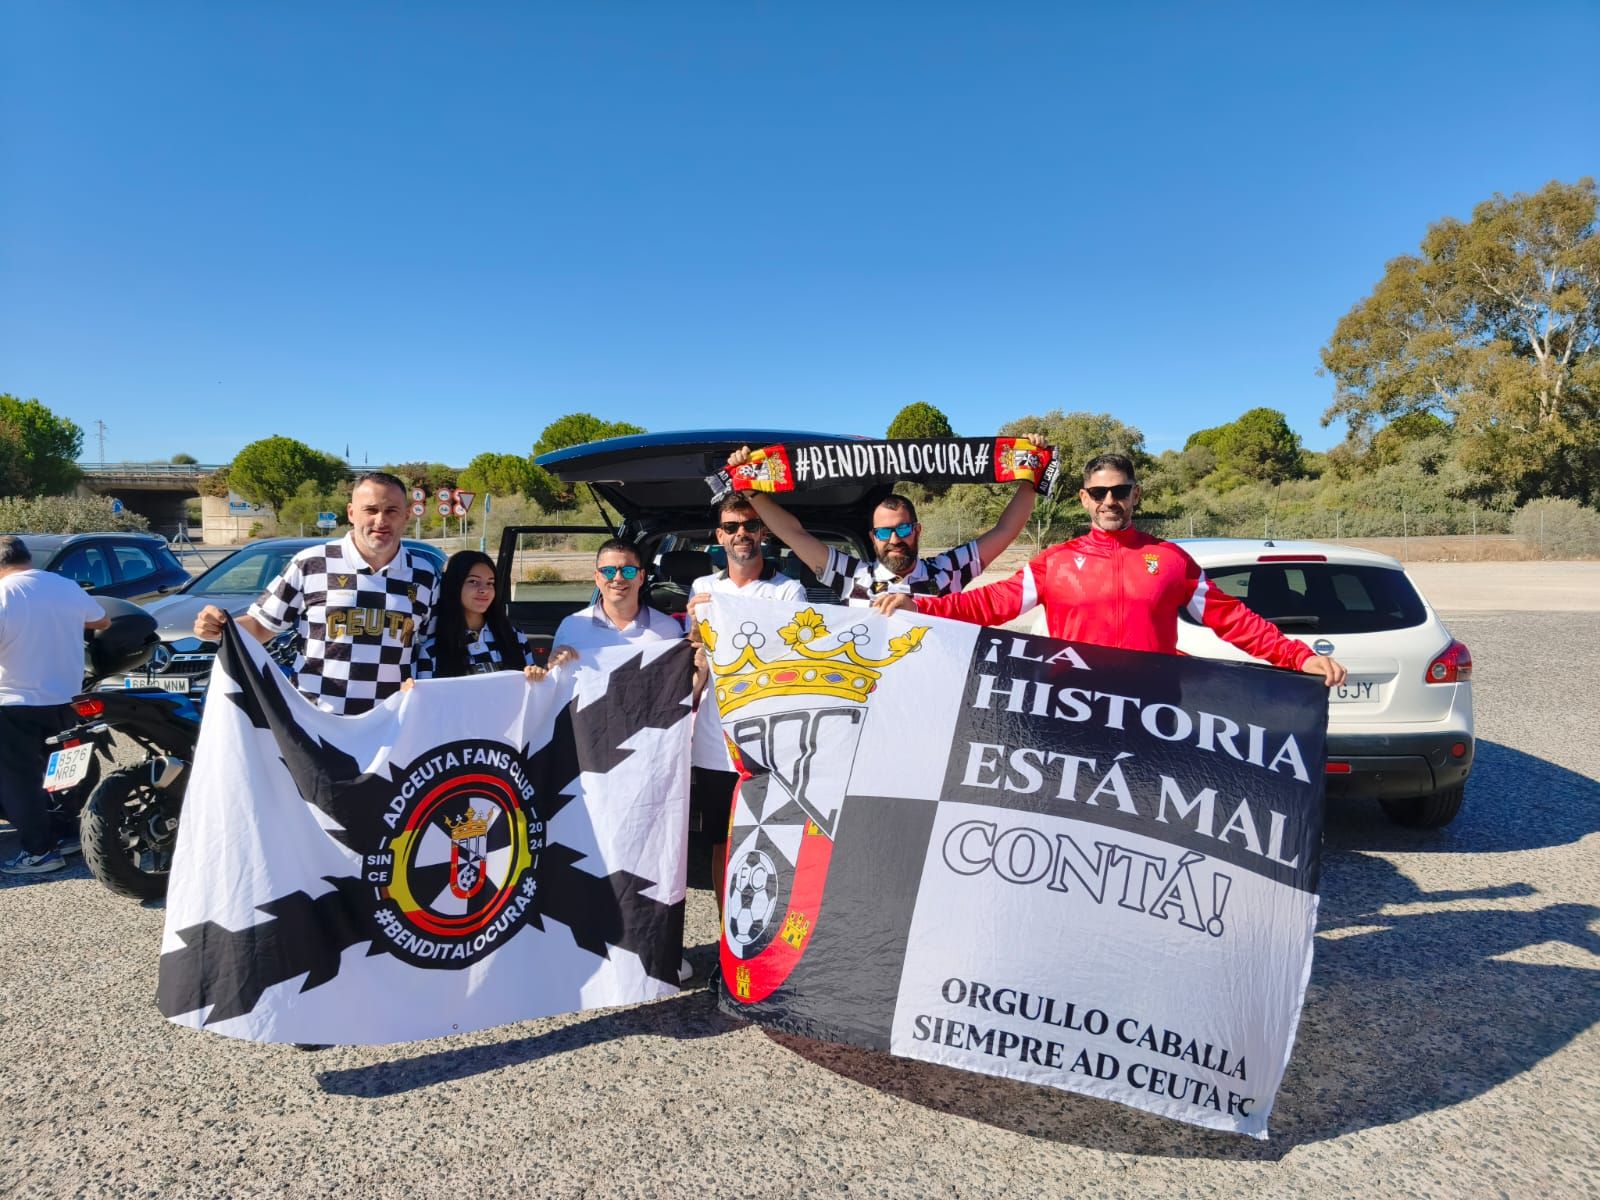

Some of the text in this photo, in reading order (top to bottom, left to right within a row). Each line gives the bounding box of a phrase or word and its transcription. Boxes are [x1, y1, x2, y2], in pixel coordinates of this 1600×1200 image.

[796, 443, 990, 481] #BENDITALOCURA#
[984, 637, 1092, 671] ¡LA
[164, 680, 186, 692] MNM
[1337, 682, 1373, 699] GJY
[972, 674, 1311, 784] HISTORIA
[56, 764, 77, 780] NRB
[58, 748, 87, 768] 8576
[463, 748, 511, 770] FANS
[509, 763, 535, 801] CLUB
[961, 742, 1300, 869] ESTÁ MAL
[942, 820, 1232, 937] CONTÁ!
[374, 876, 537, 959] #BENDITALOCURA#
[941, 977, 1247, 1081] ORGULLO CABALLA
[912, 1014, 1255, 1118] SIEMPRE AD CEUTA FC
